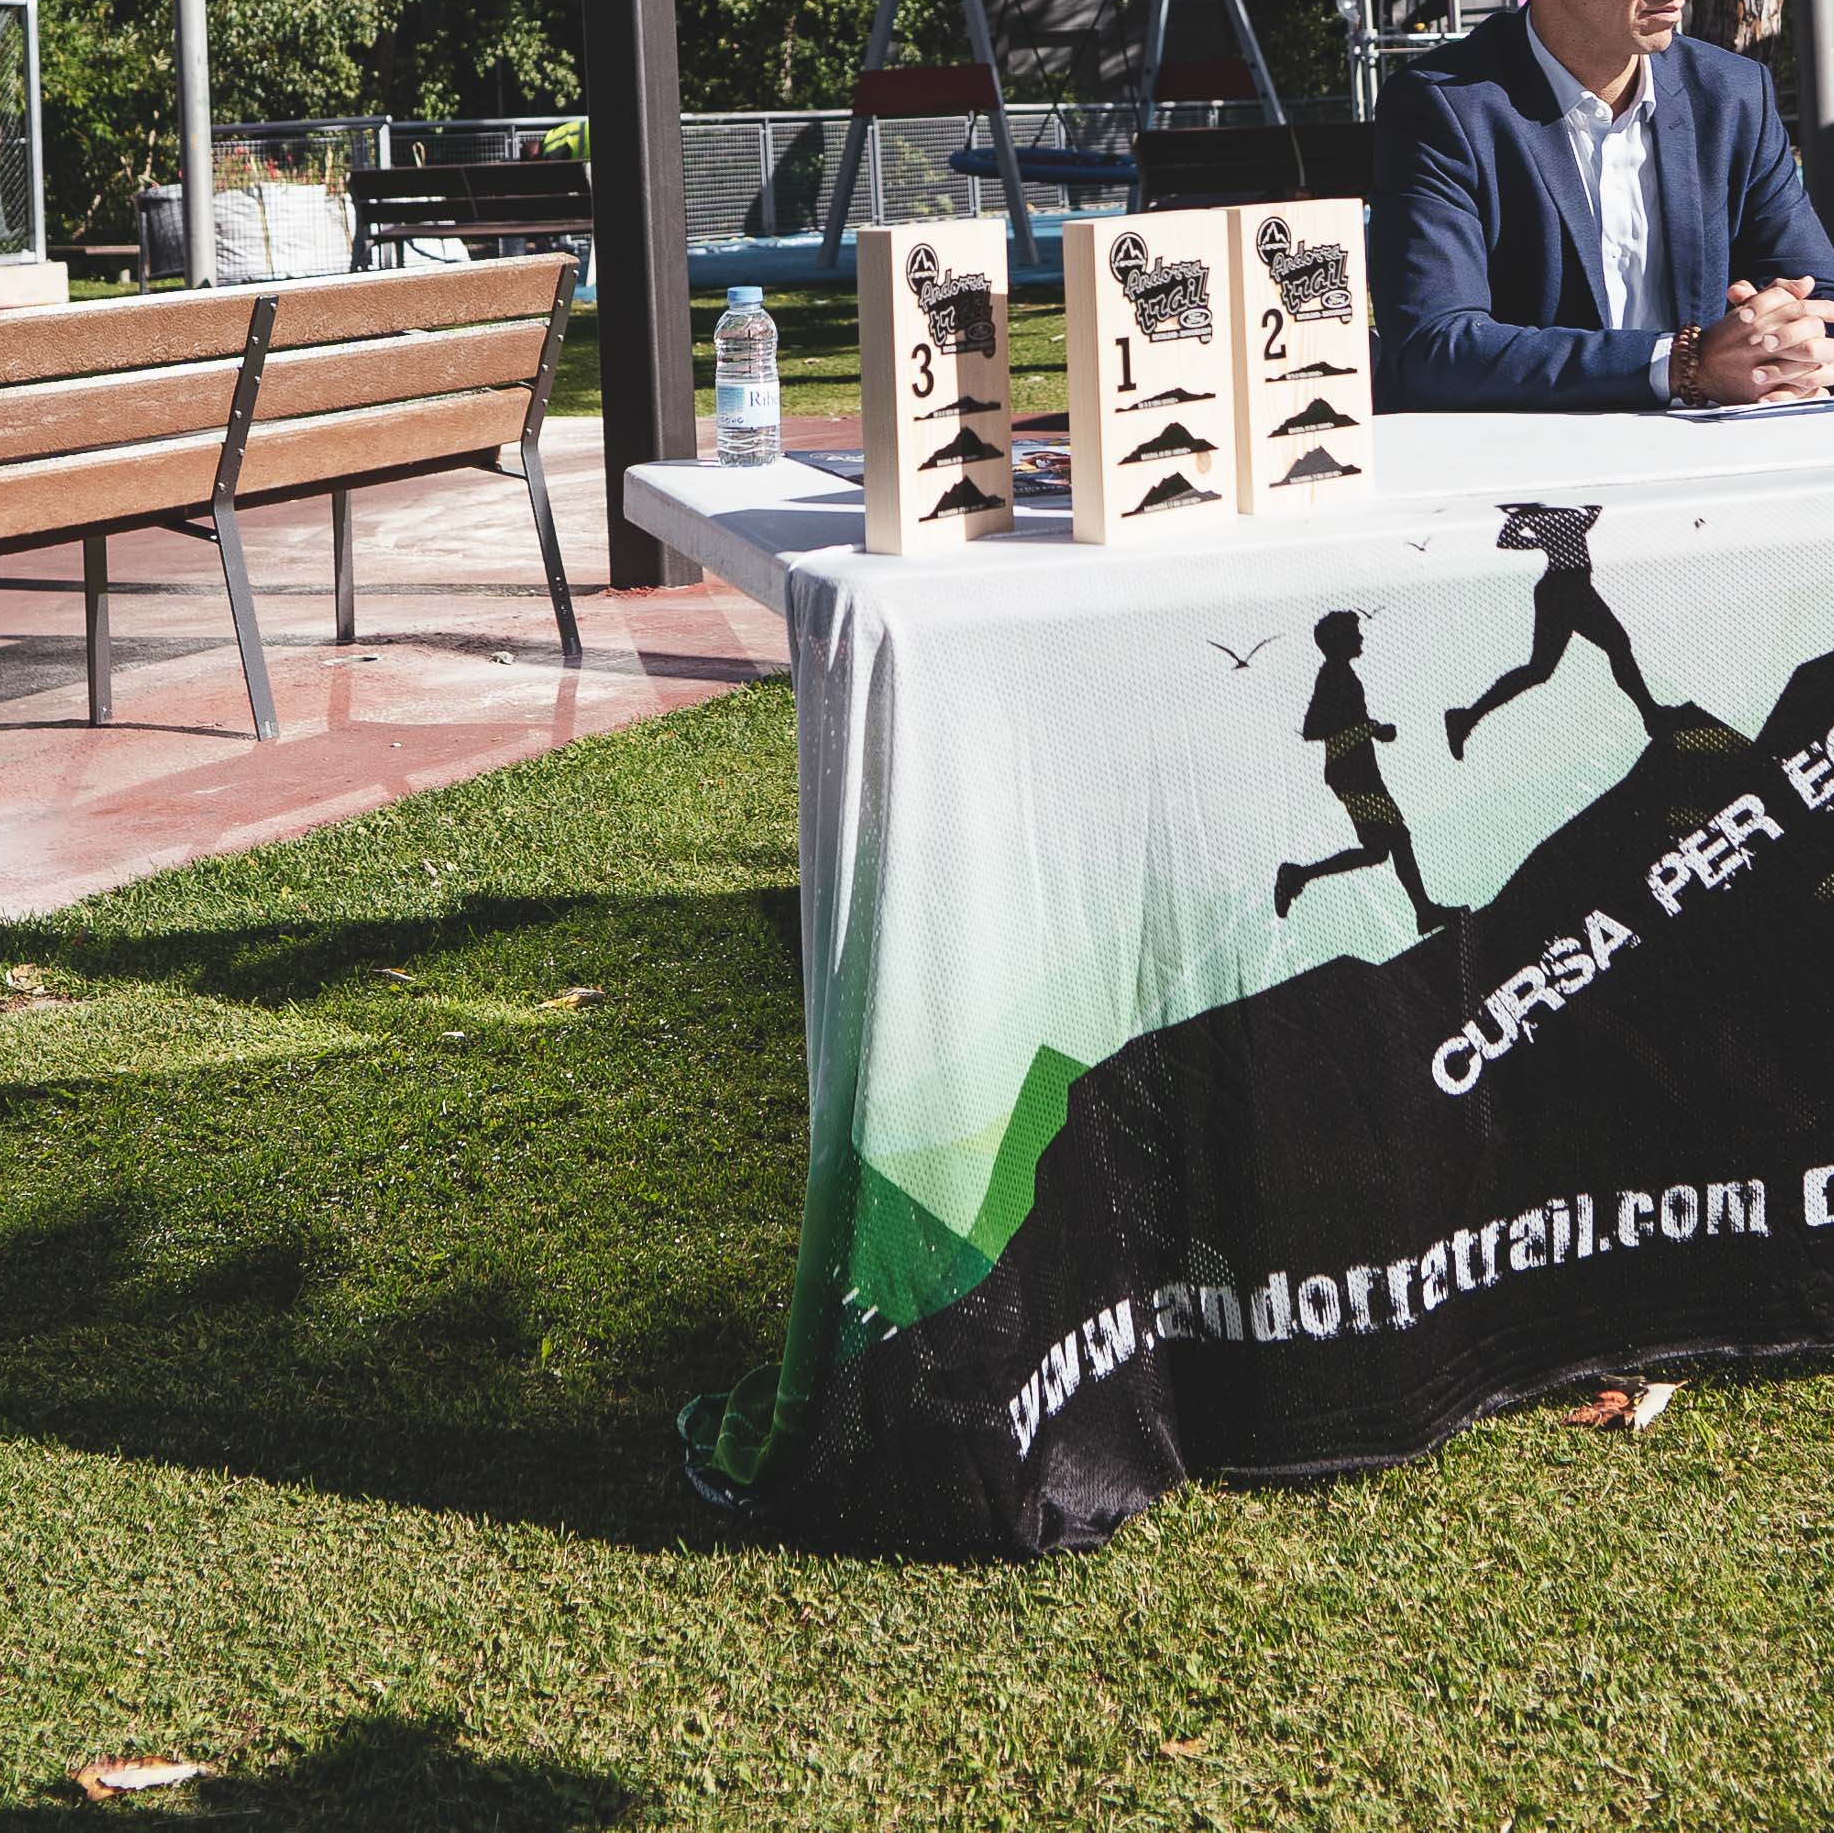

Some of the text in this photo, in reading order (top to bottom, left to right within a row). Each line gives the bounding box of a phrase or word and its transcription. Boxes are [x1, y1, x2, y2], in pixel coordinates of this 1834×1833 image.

[1260, 308, 1286, 360] 2
[911, 343, 934, 398] 3
[1115, 337, 1137, 393] 1
[1431, 908, 1642, 1097] CURSA
[1646, 788, 1785, 917] PER
[1008, 1177, 1771, 1464] www.andorratrail.com
